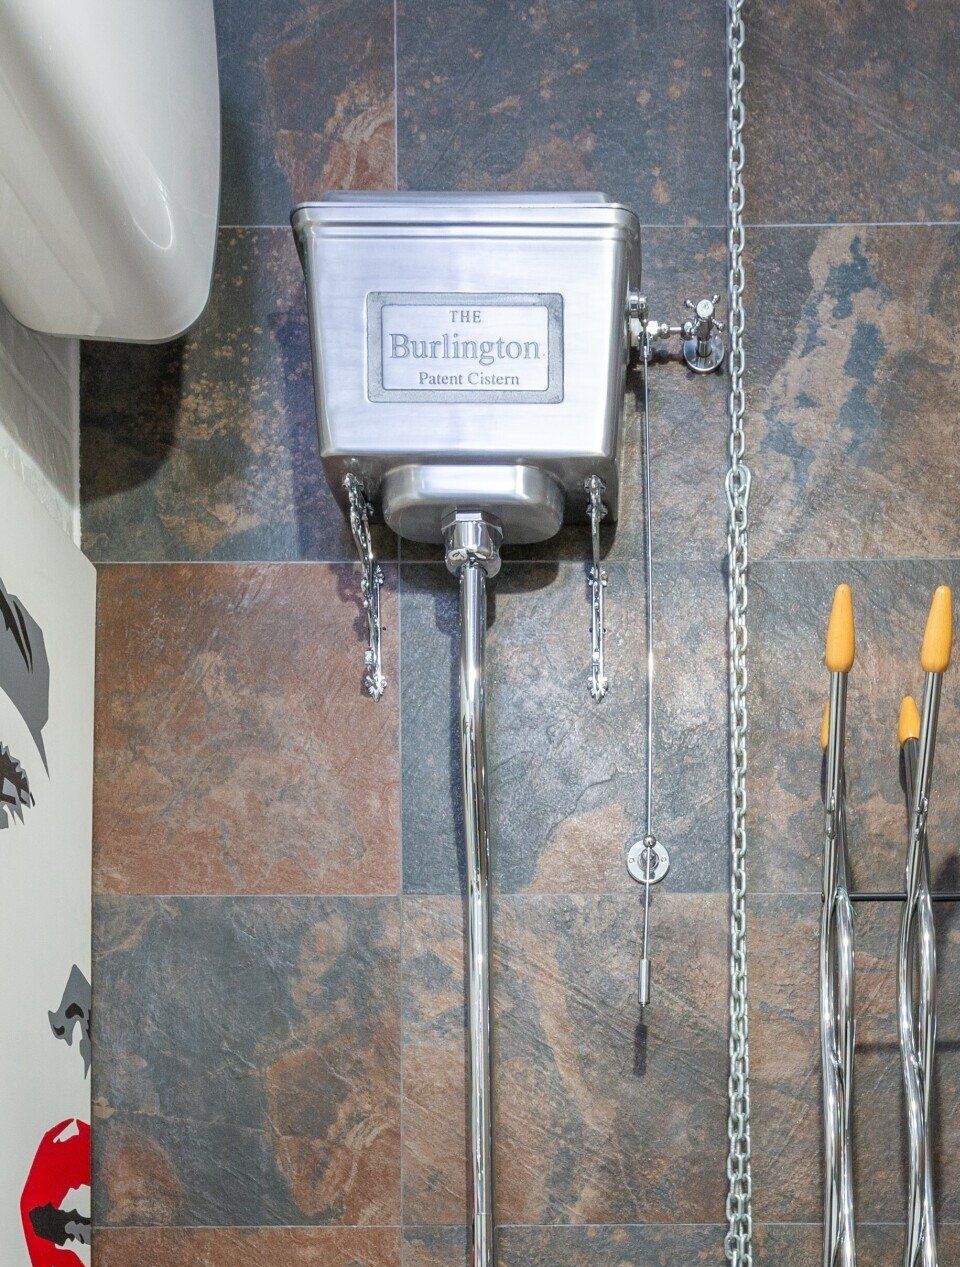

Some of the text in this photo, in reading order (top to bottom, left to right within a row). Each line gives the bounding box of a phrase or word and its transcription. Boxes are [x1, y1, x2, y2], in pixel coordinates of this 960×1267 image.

[449, 310, 482, 324] THE
[389, 333, 540, 366] Burlington
[419, 372, 520, 385] Patent Cistern
